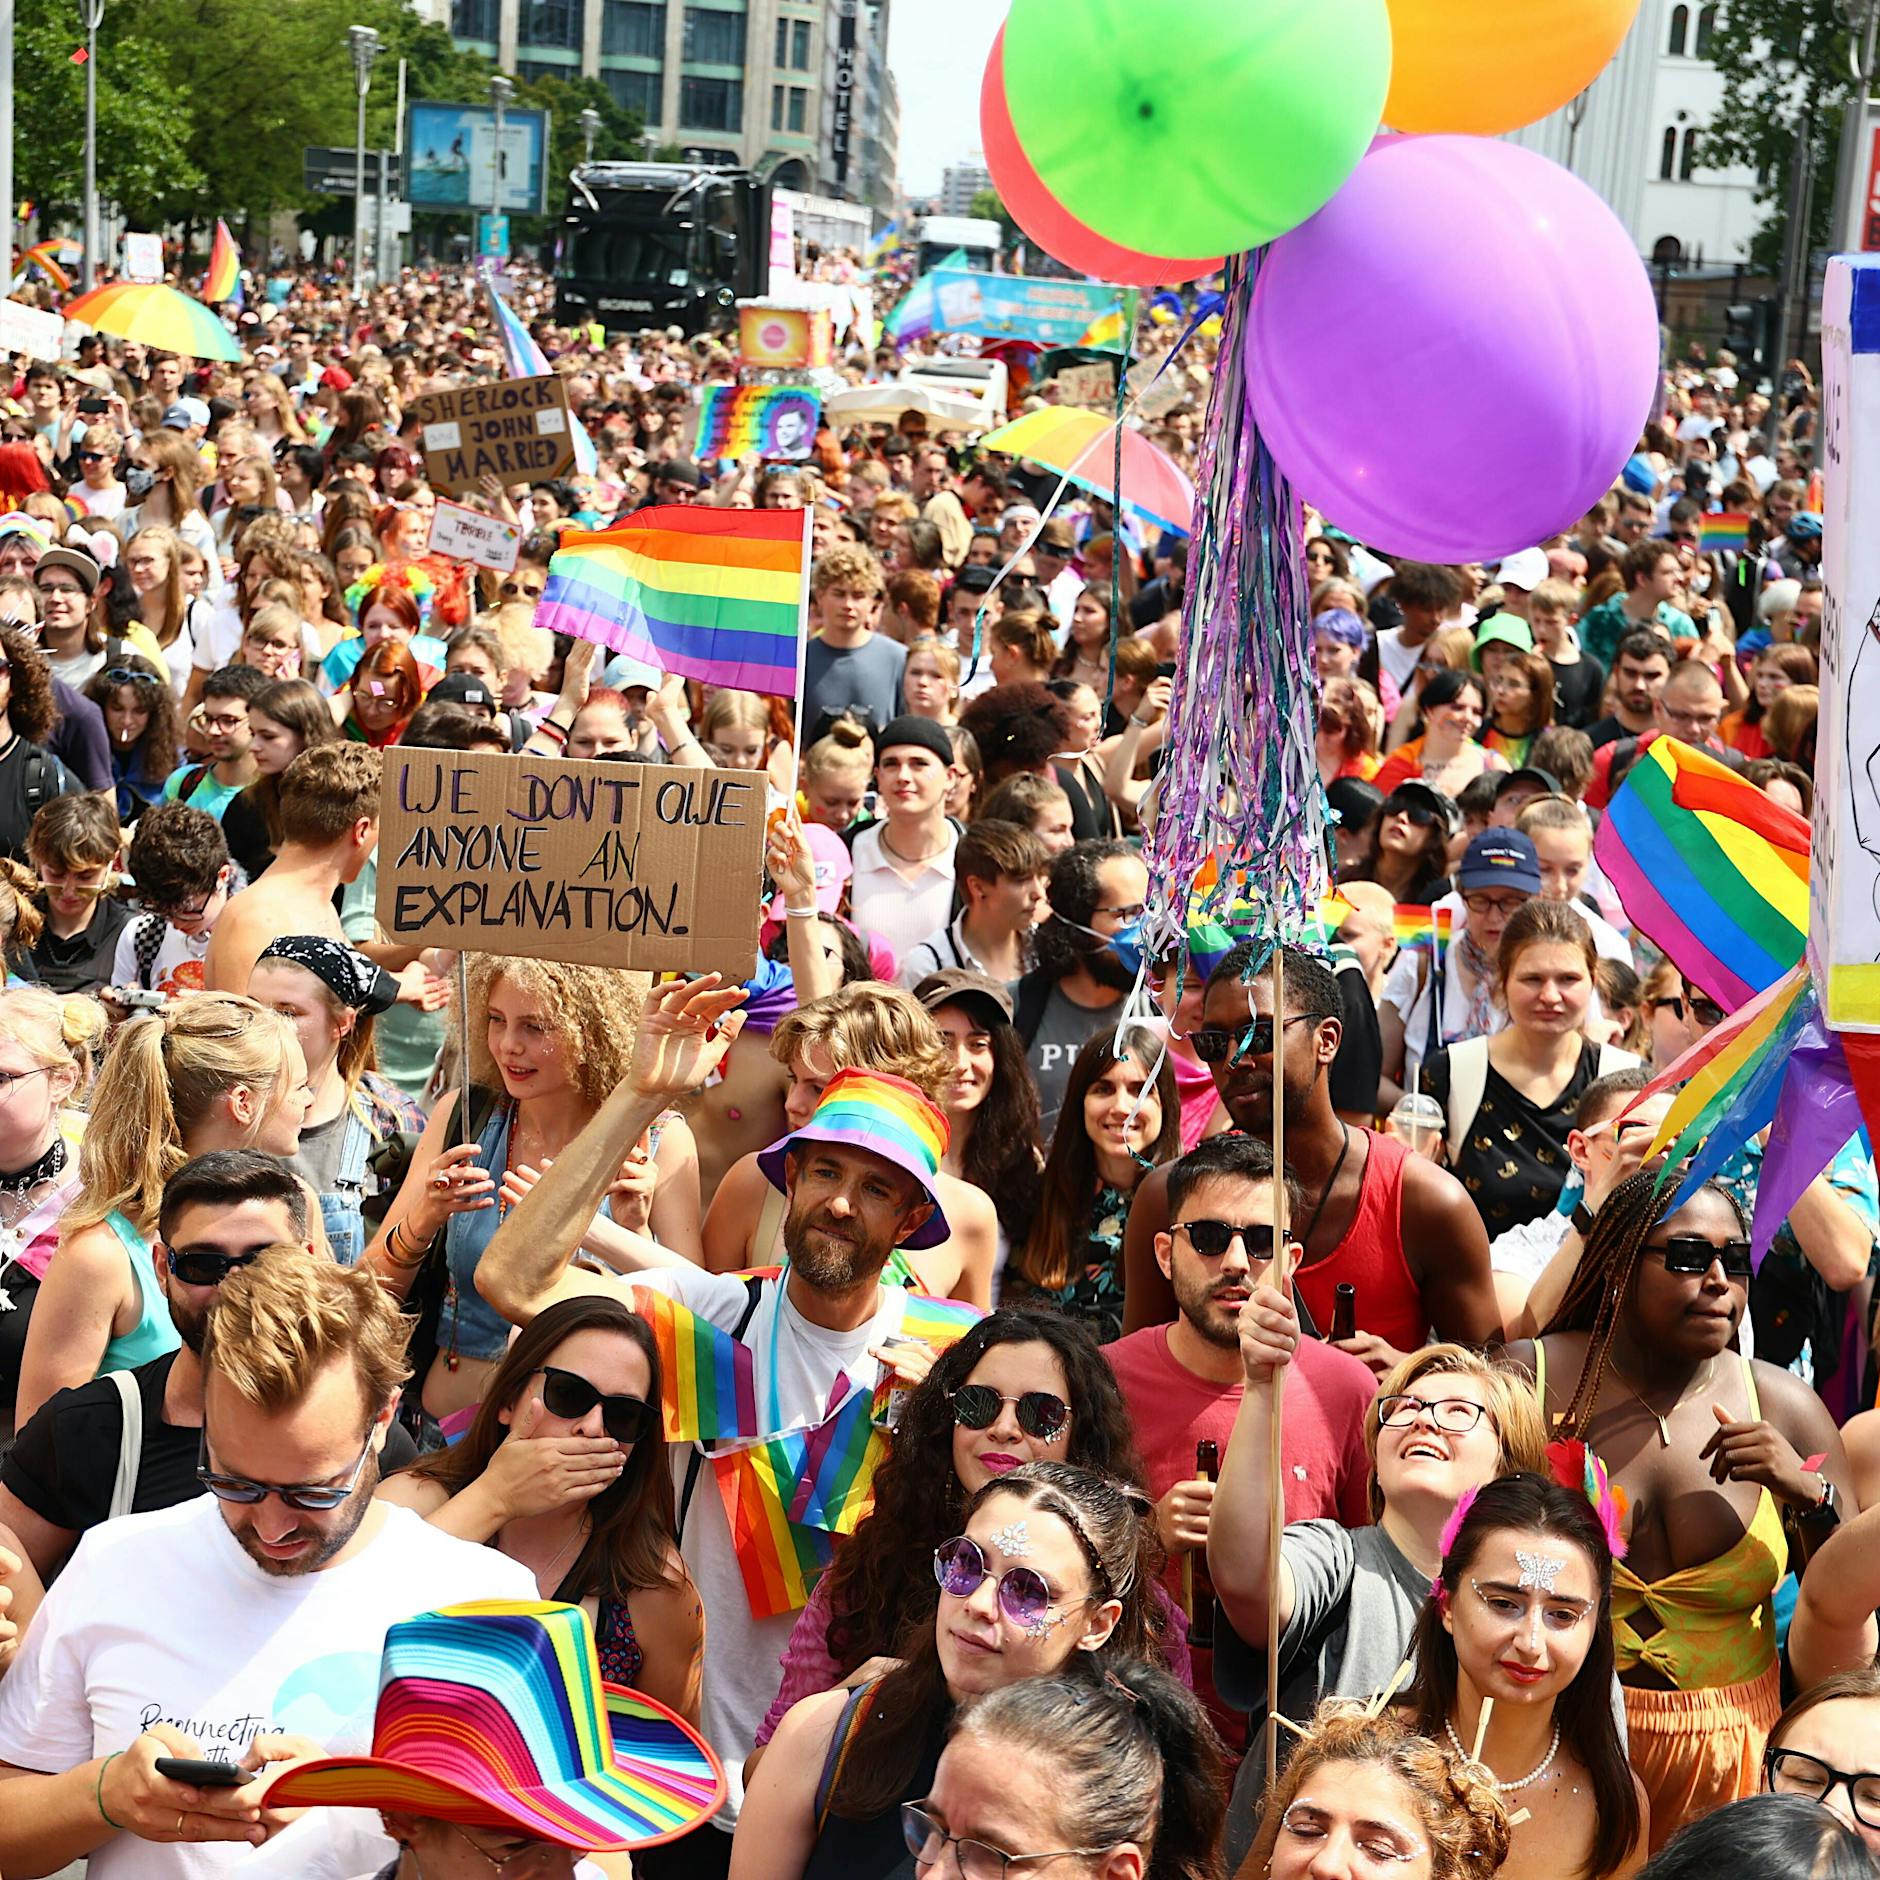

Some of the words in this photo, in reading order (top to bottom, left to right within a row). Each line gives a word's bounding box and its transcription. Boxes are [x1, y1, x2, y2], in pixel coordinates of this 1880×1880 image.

[834, 46, 855, 153] HOTEL
[420, 380, 555, 424] SHERLOCK
[469, 414, 533, 443] JOHN
[445, 439, 558, 482] MARRIED
[399, 763, 480, 814] WE
[506, 774, 641, 825] DON'T
[656, 778, 752, 826] OWE
[395, 823, 549, 873] ANYONE
[578, 830, 642, 882] AN
[394, 879, 689, 936] EXPLANATION.
